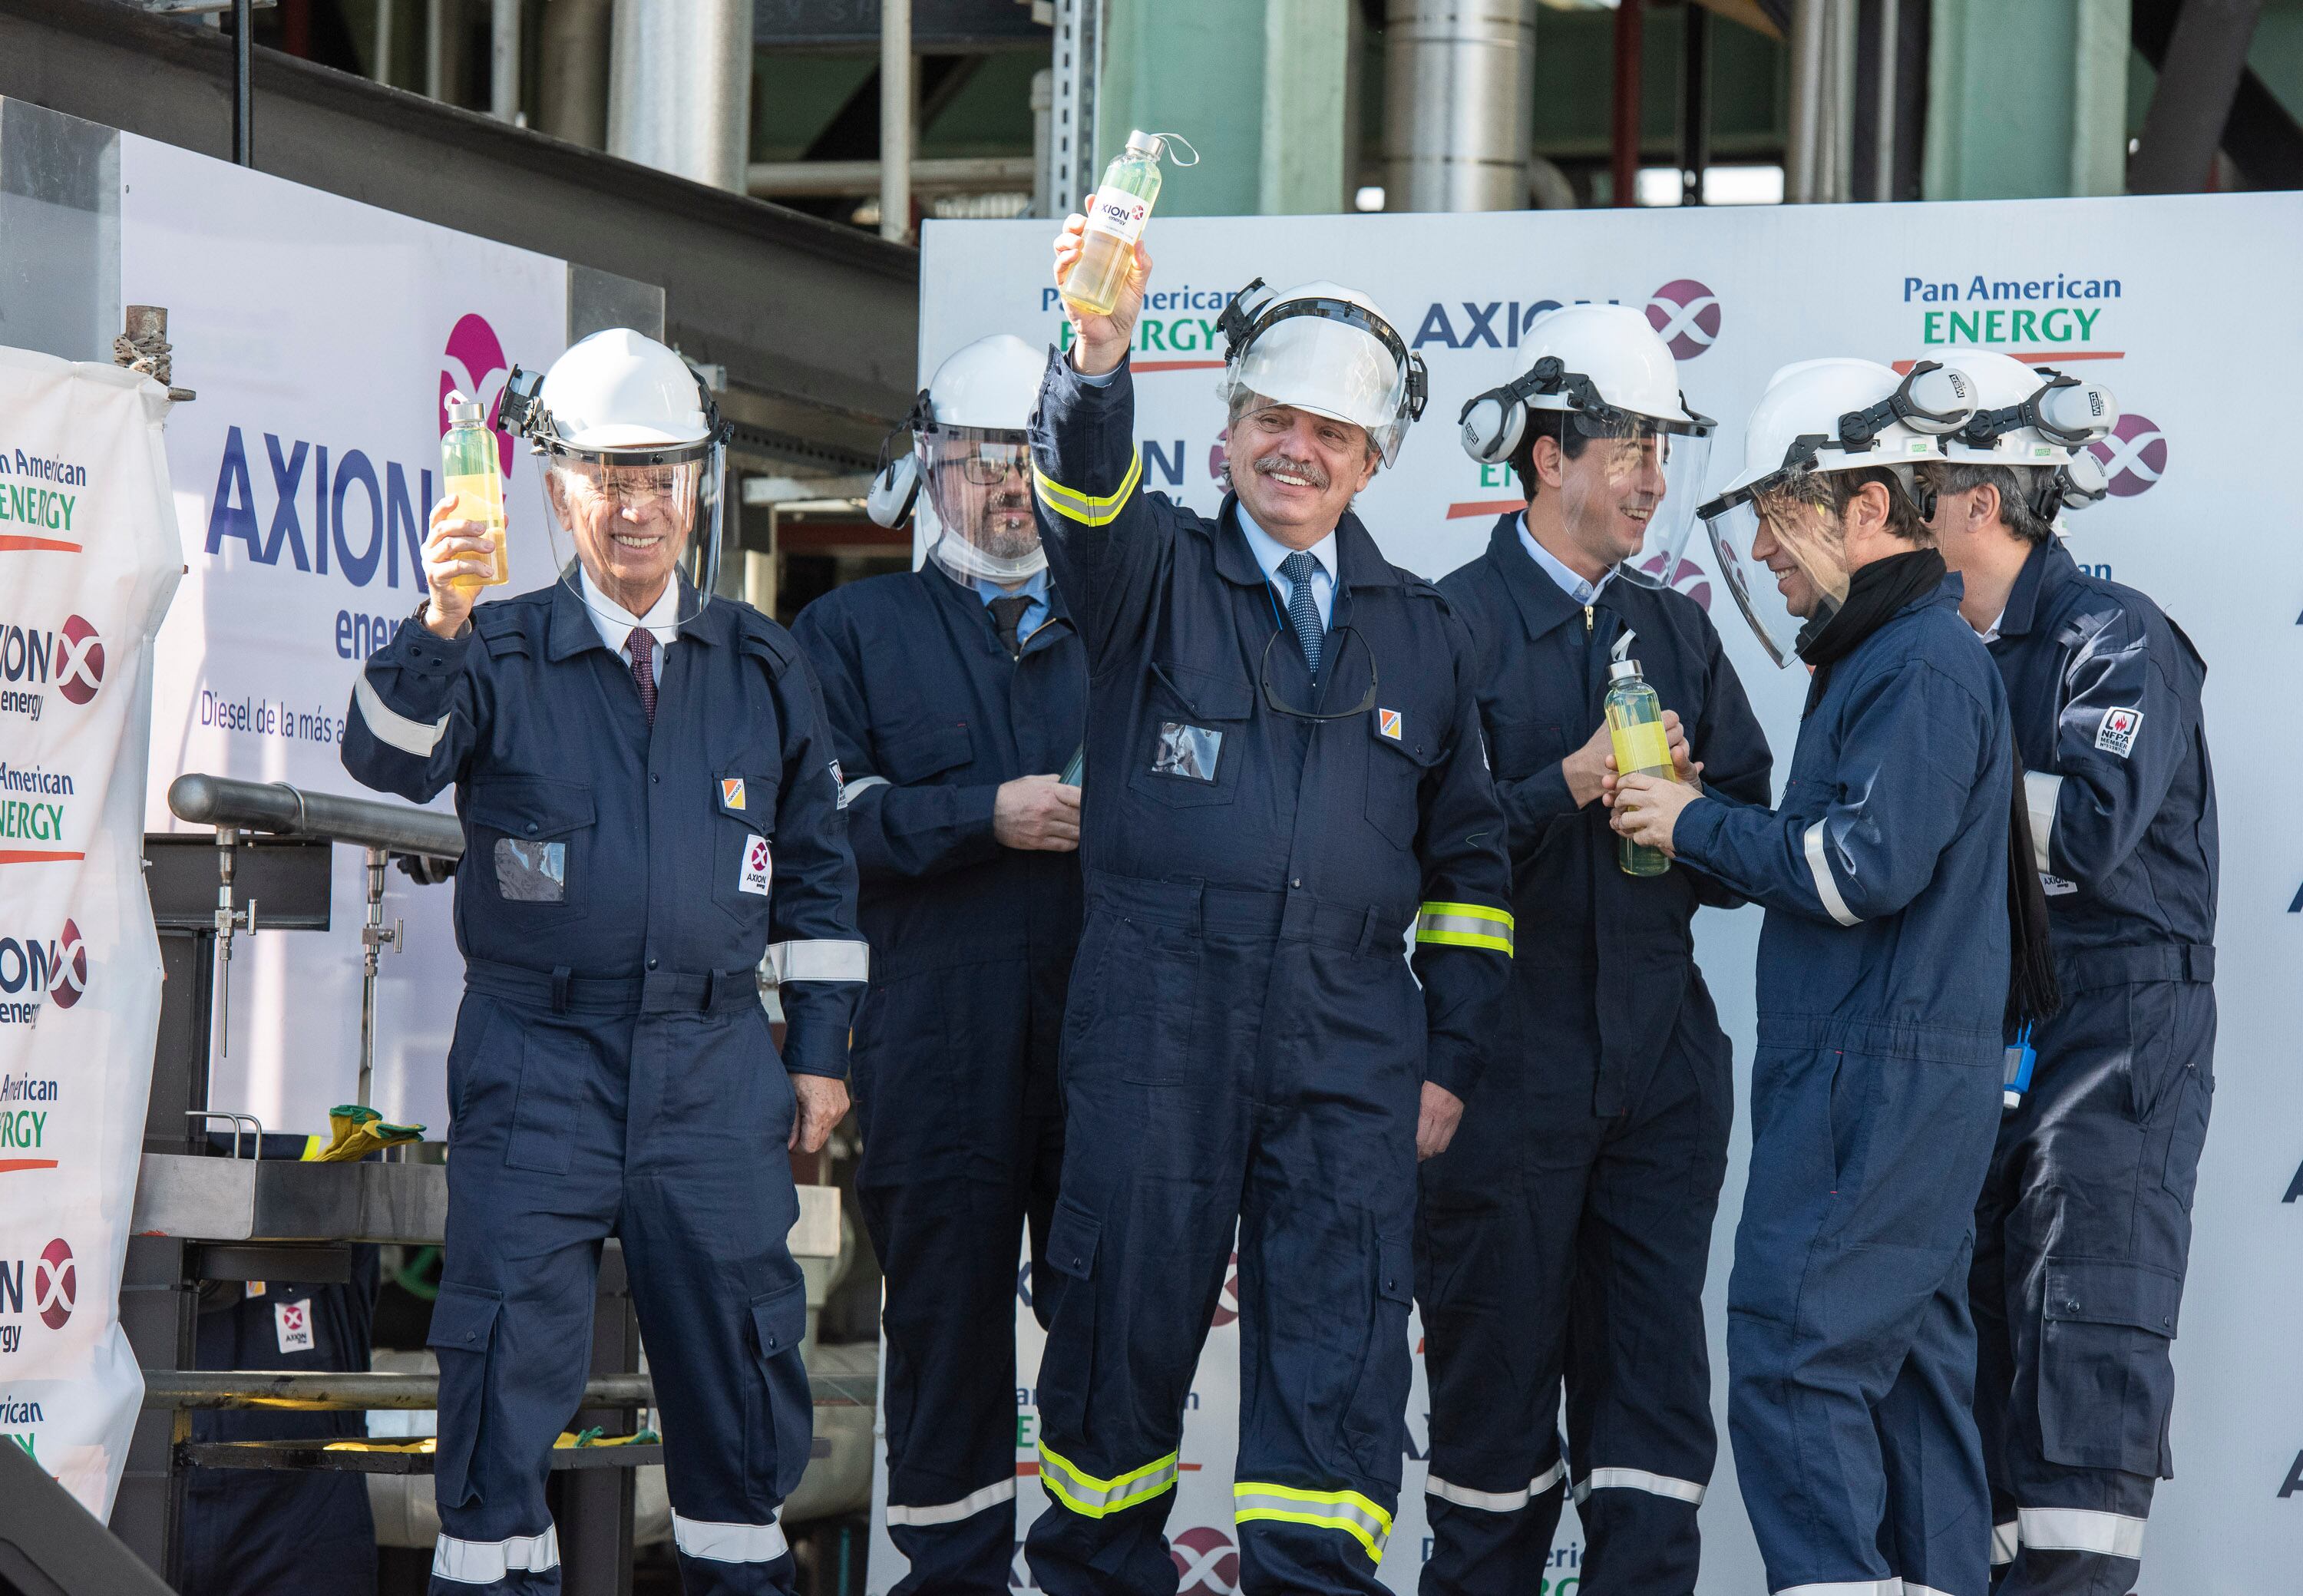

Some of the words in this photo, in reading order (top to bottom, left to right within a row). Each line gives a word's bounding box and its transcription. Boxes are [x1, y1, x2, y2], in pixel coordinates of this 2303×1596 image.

[1101, 203, 1130, 220] XION
[1108, 216, 1126, 226] energy
[1905, 277, 1958, 302] Pan
[1967, 273, 2121, 301] American
[1060, 319, 1218, 352] ERGY
[1411, 299, 1619, 349] AXI
[1925, 308, 2101, 344] ENERGY
[1949, 375, 1965, 398] MSA
[2089, 392, 2101, 415] MSA
[15, 448, 86, 487] American
[204, 425, 431, 593] AXION
[335, 610, 399, 660] ener
[0, 623, 52, 684] ION
[1, 690, 44, 722] energy
[202, 690, 251, 732] Diesel
[256, 699, 275, 735] de
[280, 702, 294, 737] la
[299, 705, 332, 742] más
[2100, 737, 2128, 749] MEMBER
[2101, 729, 2129, 744] NFPA
[747, 873, 767, 884] AXION
[0, 1395, 44, 1423] rican
